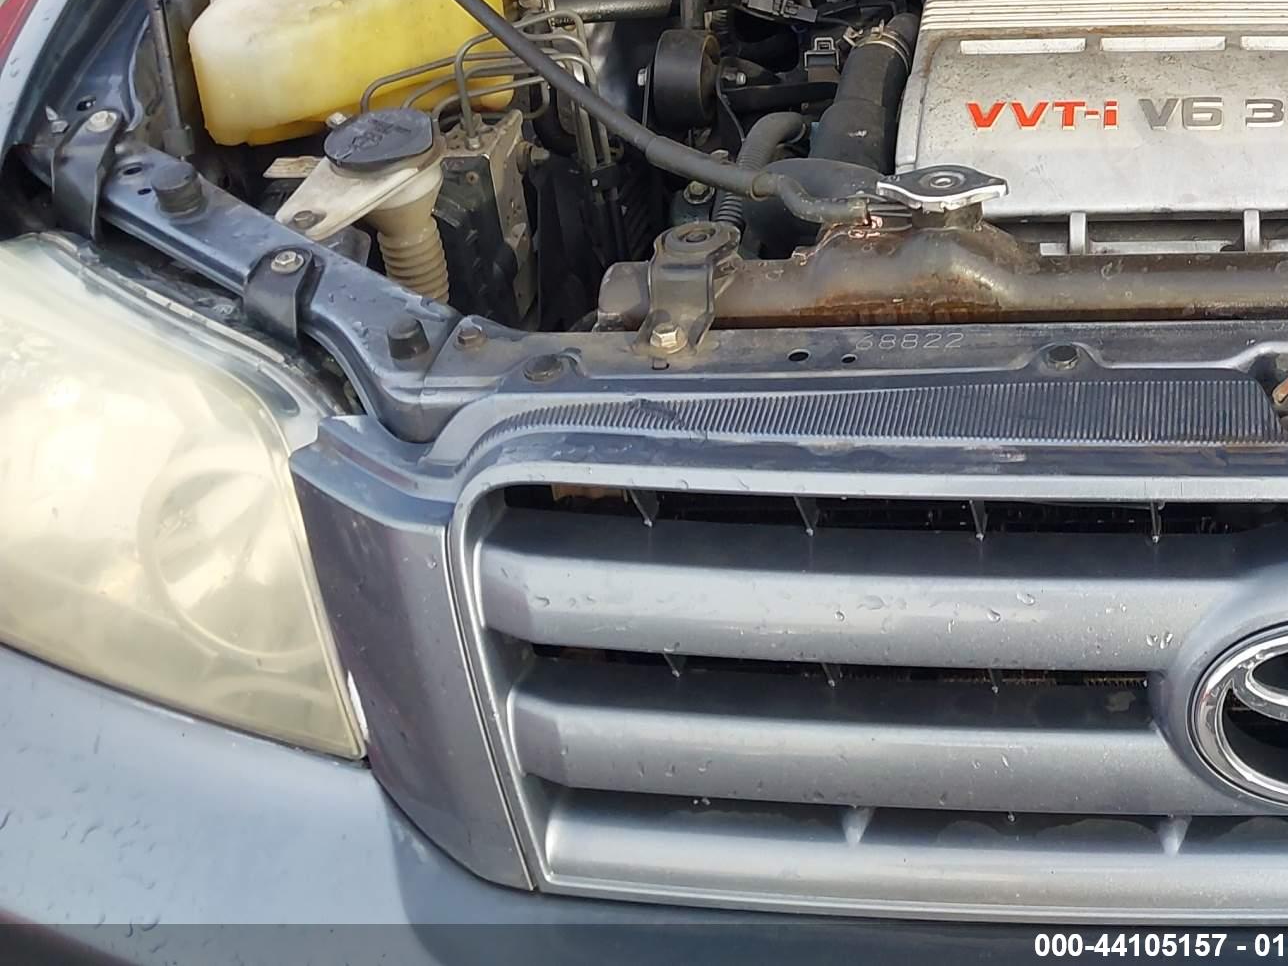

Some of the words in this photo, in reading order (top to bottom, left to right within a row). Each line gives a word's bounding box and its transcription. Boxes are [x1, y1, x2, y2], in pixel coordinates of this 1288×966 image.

[966, 101, 1120, 131] VVT-i
[1138, 97, 1225, 131] V6
[855, 332, 965, 351] 68822
